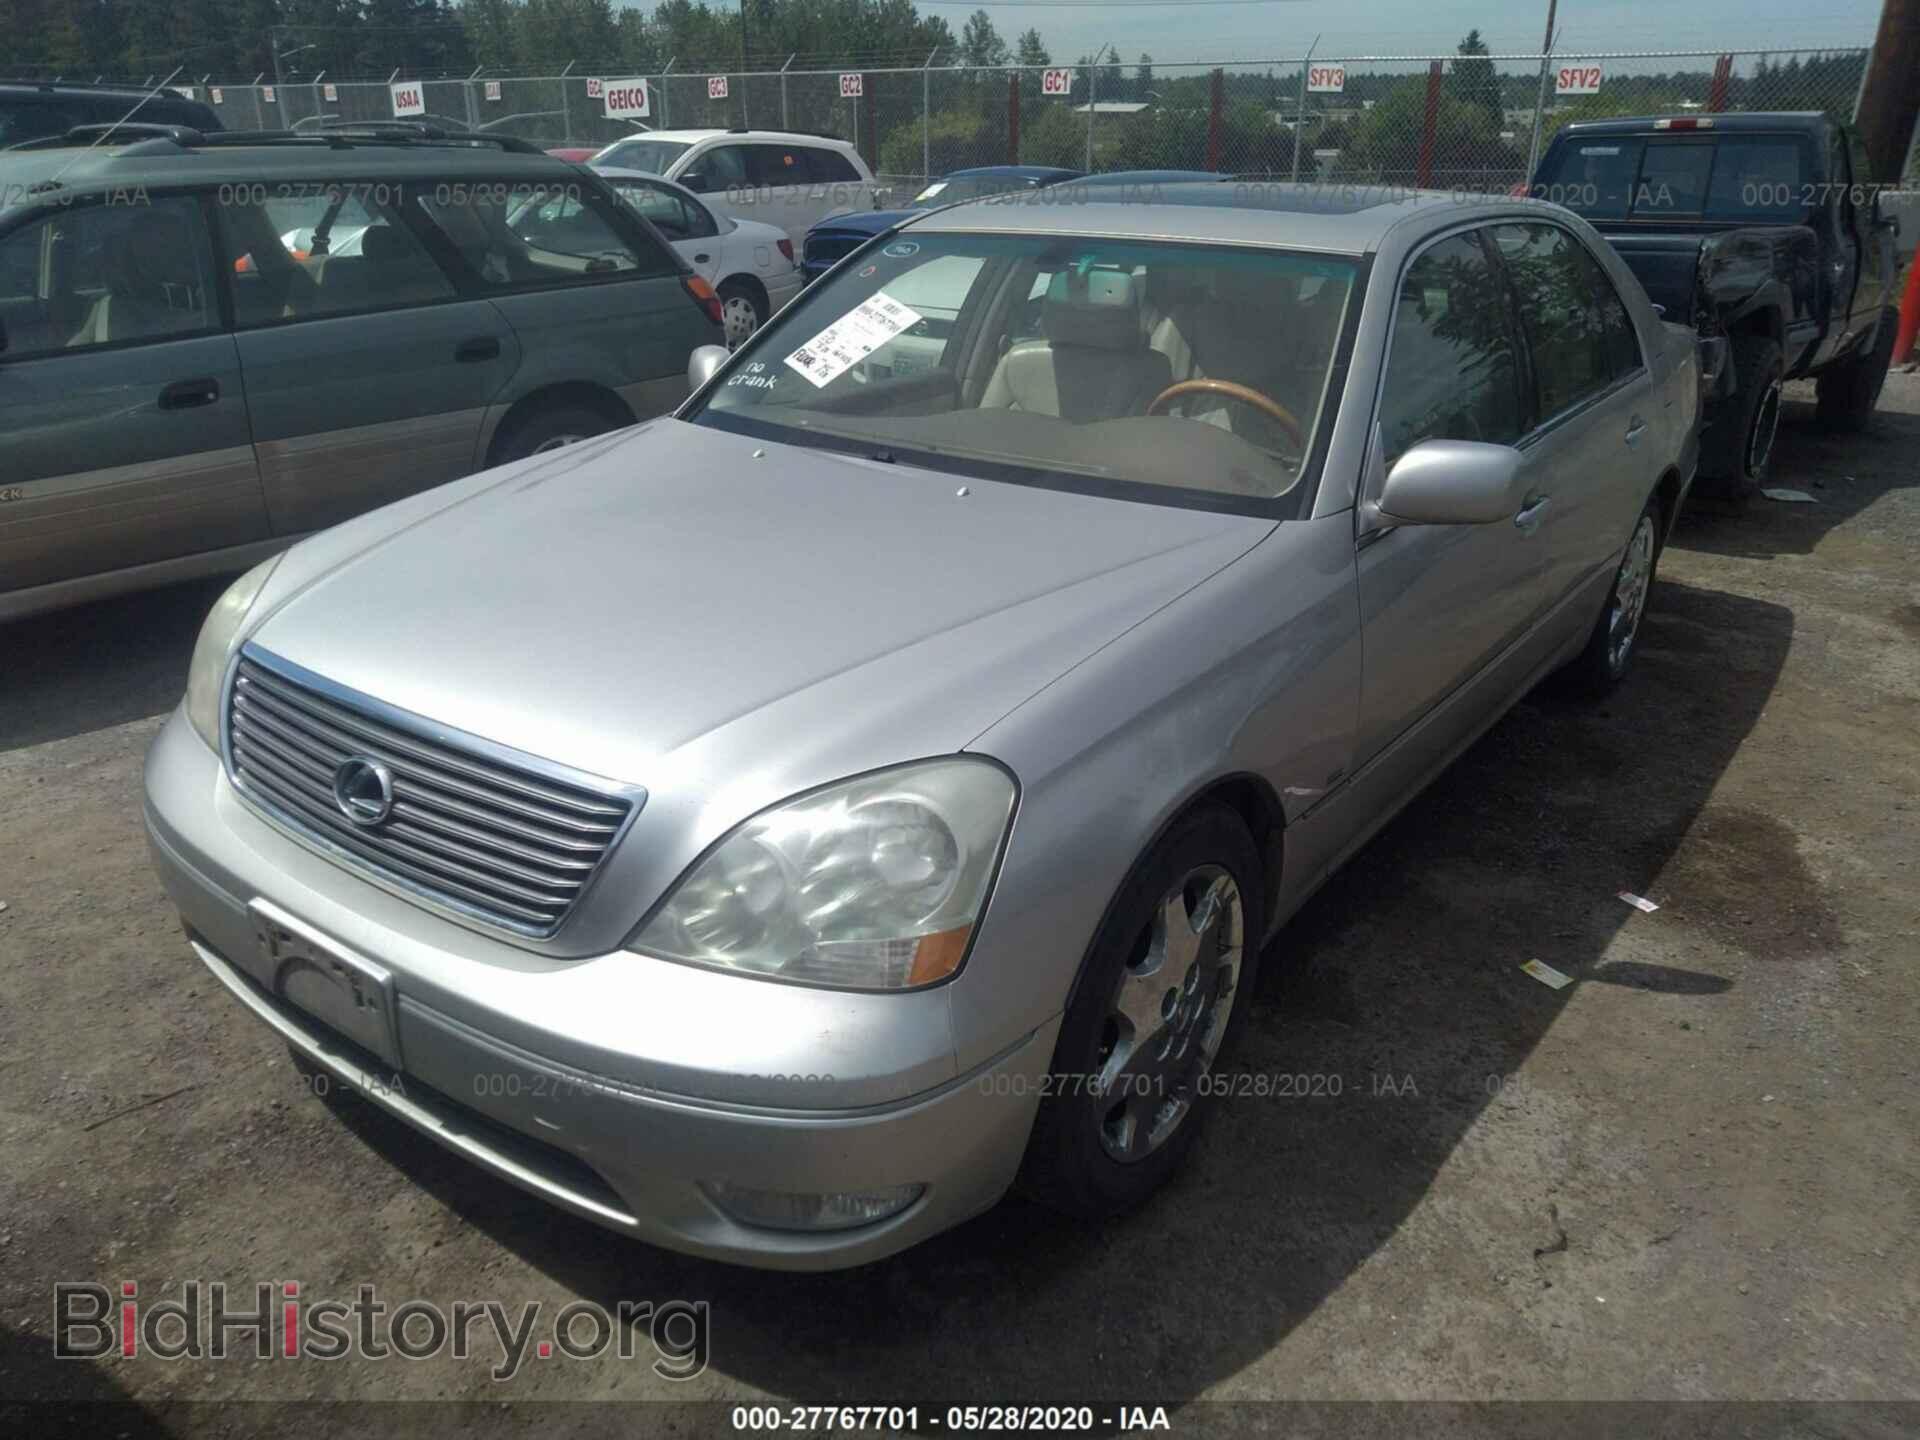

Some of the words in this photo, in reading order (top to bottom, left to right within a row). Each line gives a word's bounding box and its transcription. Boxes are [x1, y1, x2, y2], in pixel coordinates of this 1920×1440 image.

[842, 76, 861, 94] GC2
[1045, 71, 1068, 91] GC1
[1310, 68, 1344, 87] SFV3
[1558, 67, 1600, 88] SFV2
[395, 89, 420, 108] USAA
[608, 88, 645, 110] GEICO
